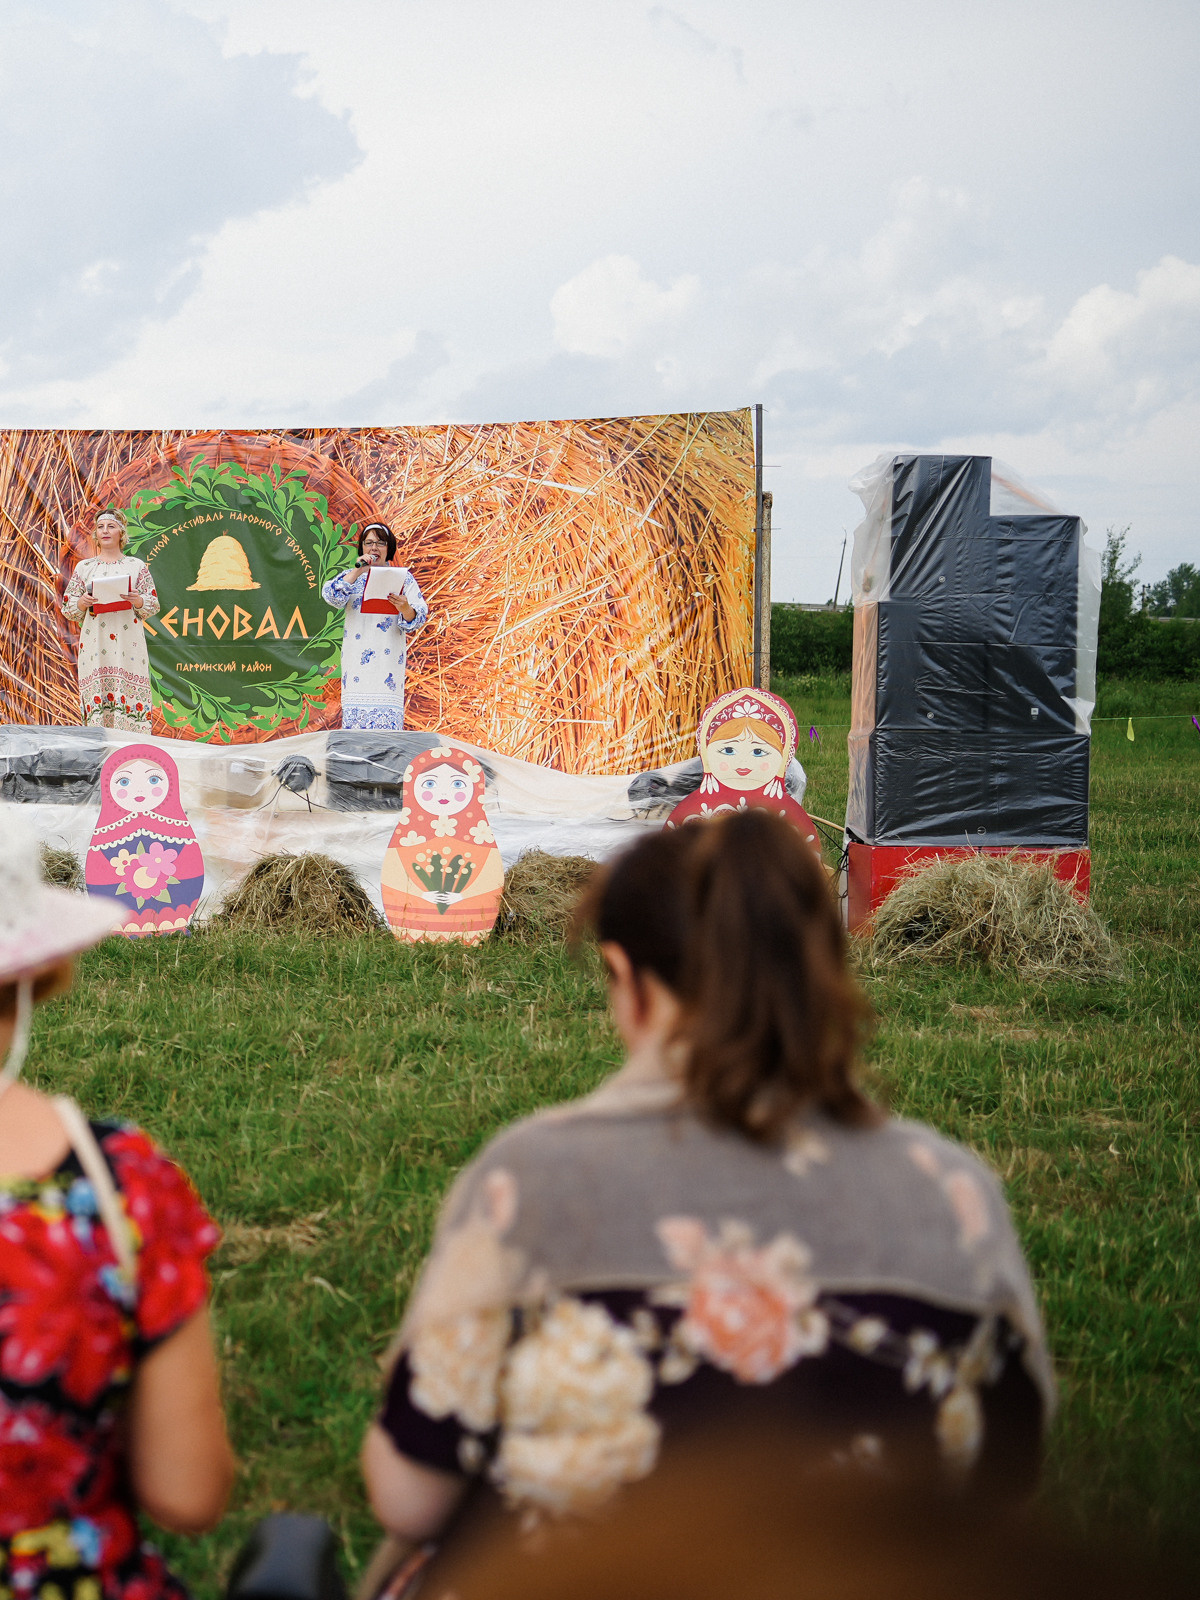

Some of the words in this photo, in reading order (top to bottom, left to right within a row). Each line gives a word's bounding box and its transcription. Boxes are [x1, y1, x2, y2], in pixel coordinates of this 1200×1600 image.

[229, 511, 282, 536] НАРОДНОГО
[284, 536, 317, 590] ТВОРЧЕСТВА
[176, 661, 237, 672] ПАРФИНСКИЙ
[241, 661, 272, 672] РАЙОН
